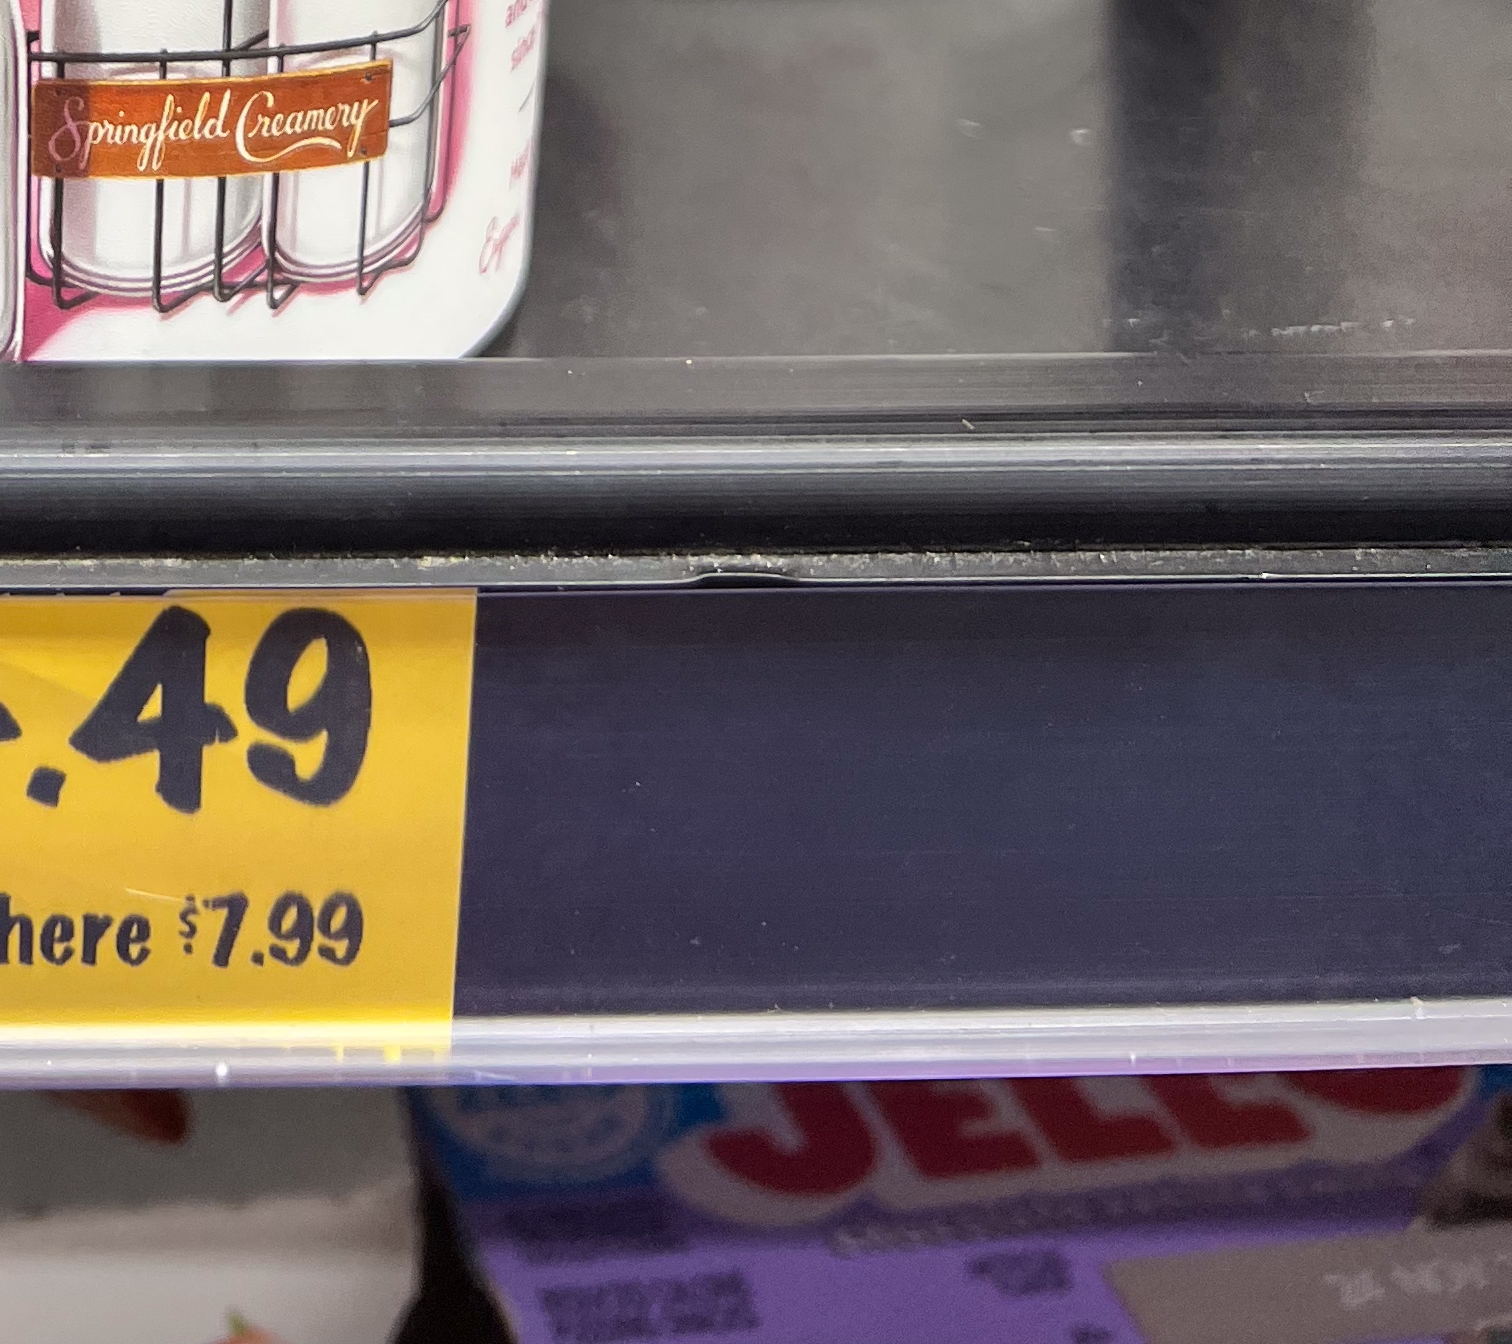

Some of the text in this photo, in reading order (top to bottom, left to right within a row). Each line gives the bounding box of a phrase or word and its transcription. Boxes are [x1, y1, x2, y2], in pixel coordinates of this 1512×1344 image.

[47, 89, 380, 173] Springfield Creamery
[178, 891, 366, 969] $7.99
